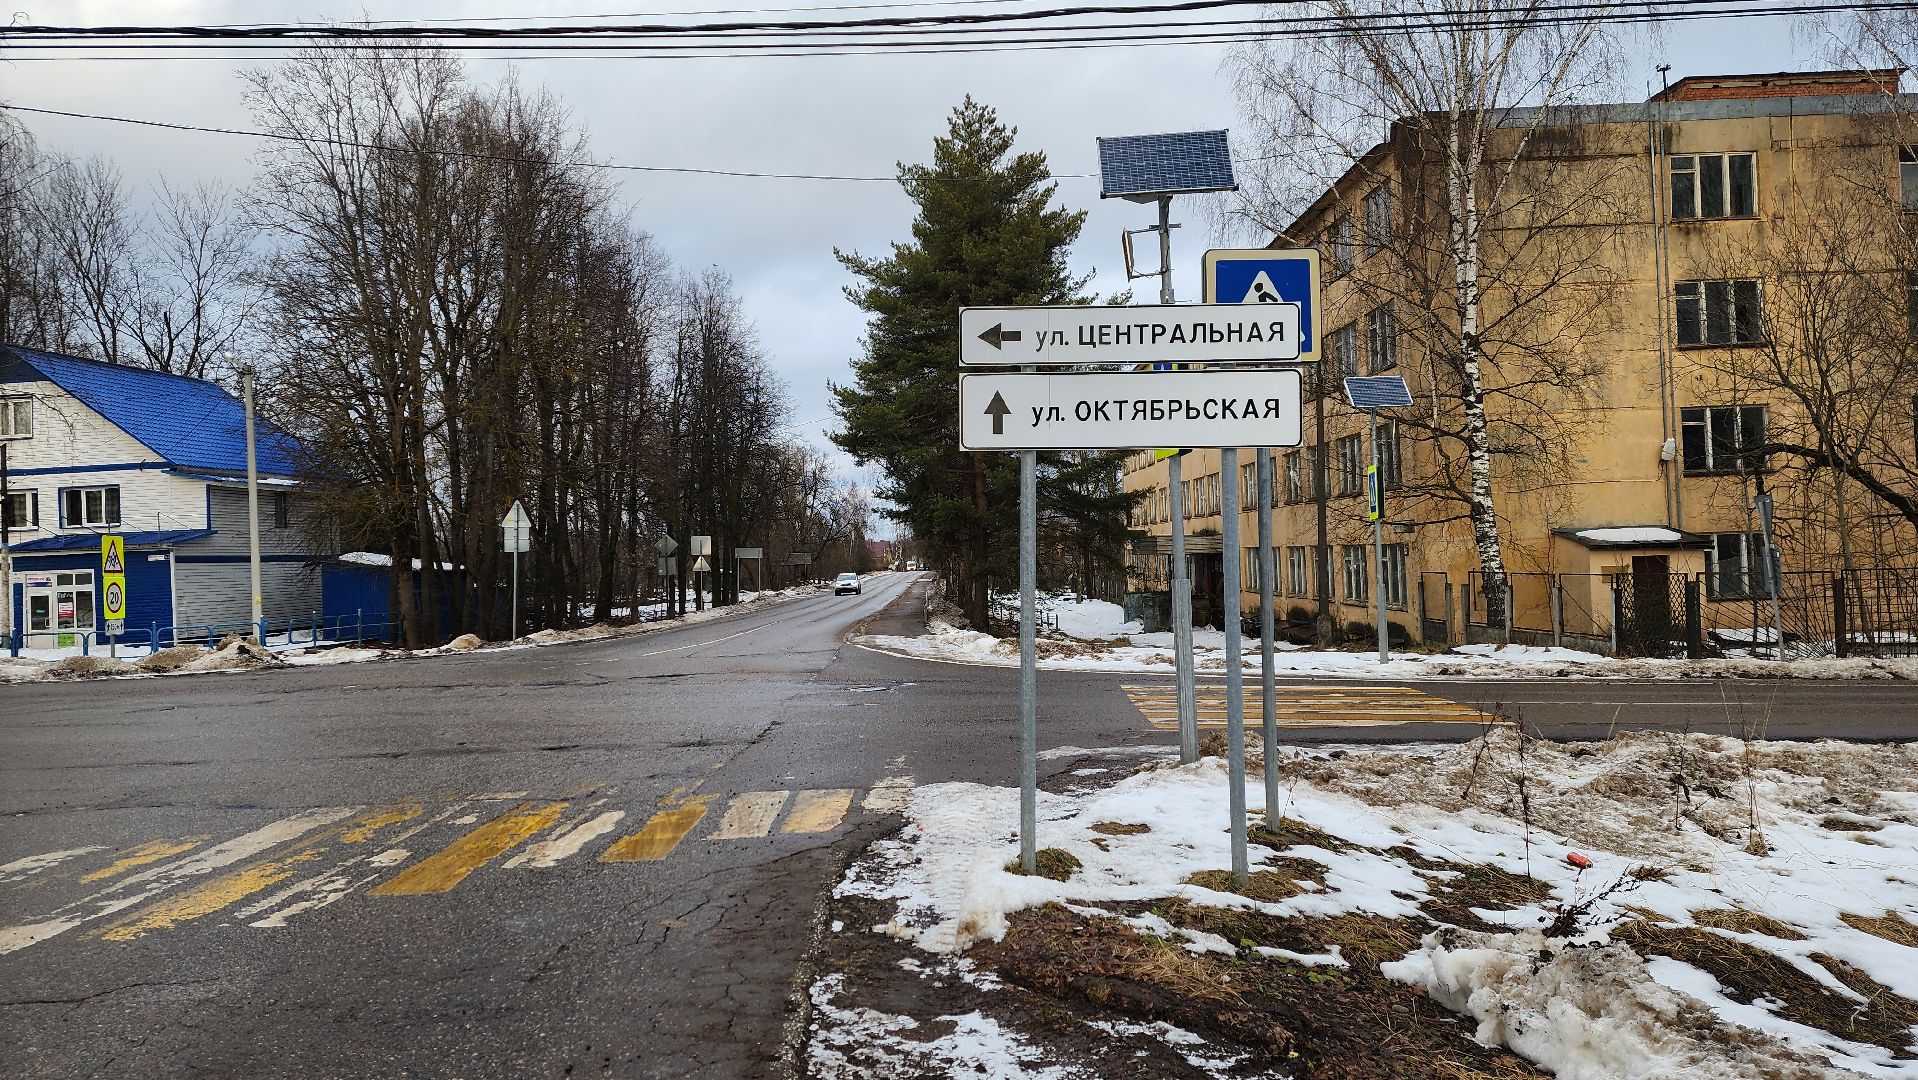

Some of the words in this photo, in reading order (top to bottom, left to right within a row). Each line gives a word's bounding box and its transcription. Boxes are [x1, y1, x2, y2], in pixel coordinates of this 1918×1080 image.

[1035, 330, 1070, 353] ул.
[1078, 321, 1284, 349] ЦЕНТРАЛЬНАЯ
[1031, 406, 1066, 428] ул.
[1074, 398, 1280, 422] ОКТЯБРЬСКАЯ
[110, 591, 120, 605] 20
